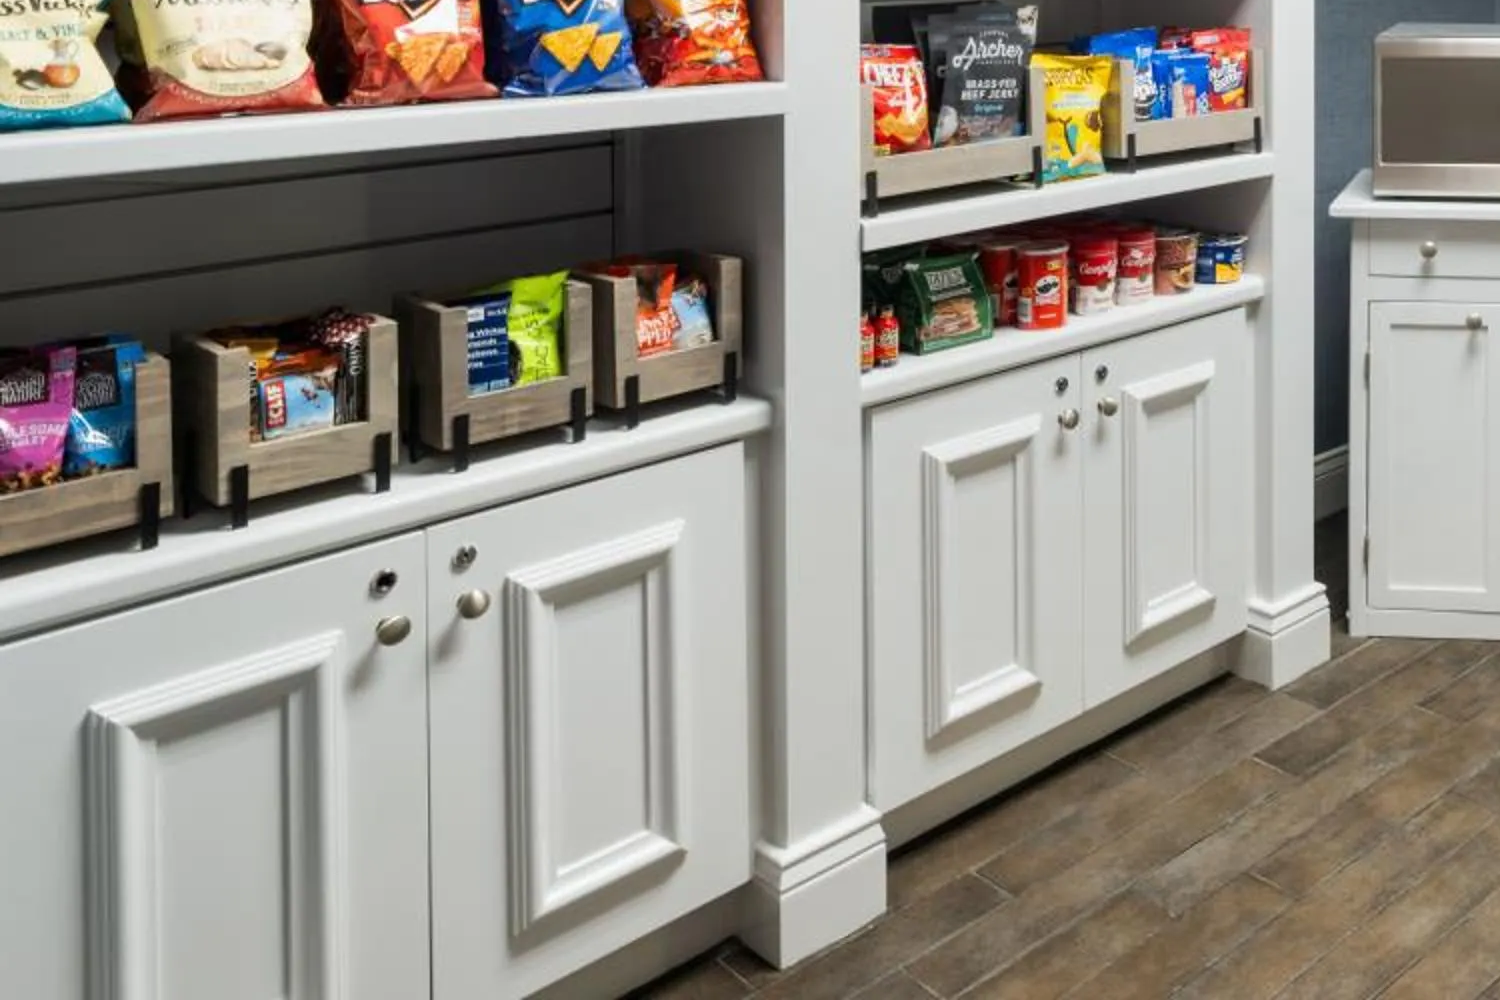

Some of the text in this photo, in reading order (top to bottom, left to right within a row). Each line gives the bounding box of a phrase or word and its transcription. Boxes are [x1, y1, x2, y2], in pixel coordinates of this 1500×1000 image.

[0, 0, 26, 17] ss
[952, 37, 1023, 71] Archer
[267, 383, 285, 416] CLIF
